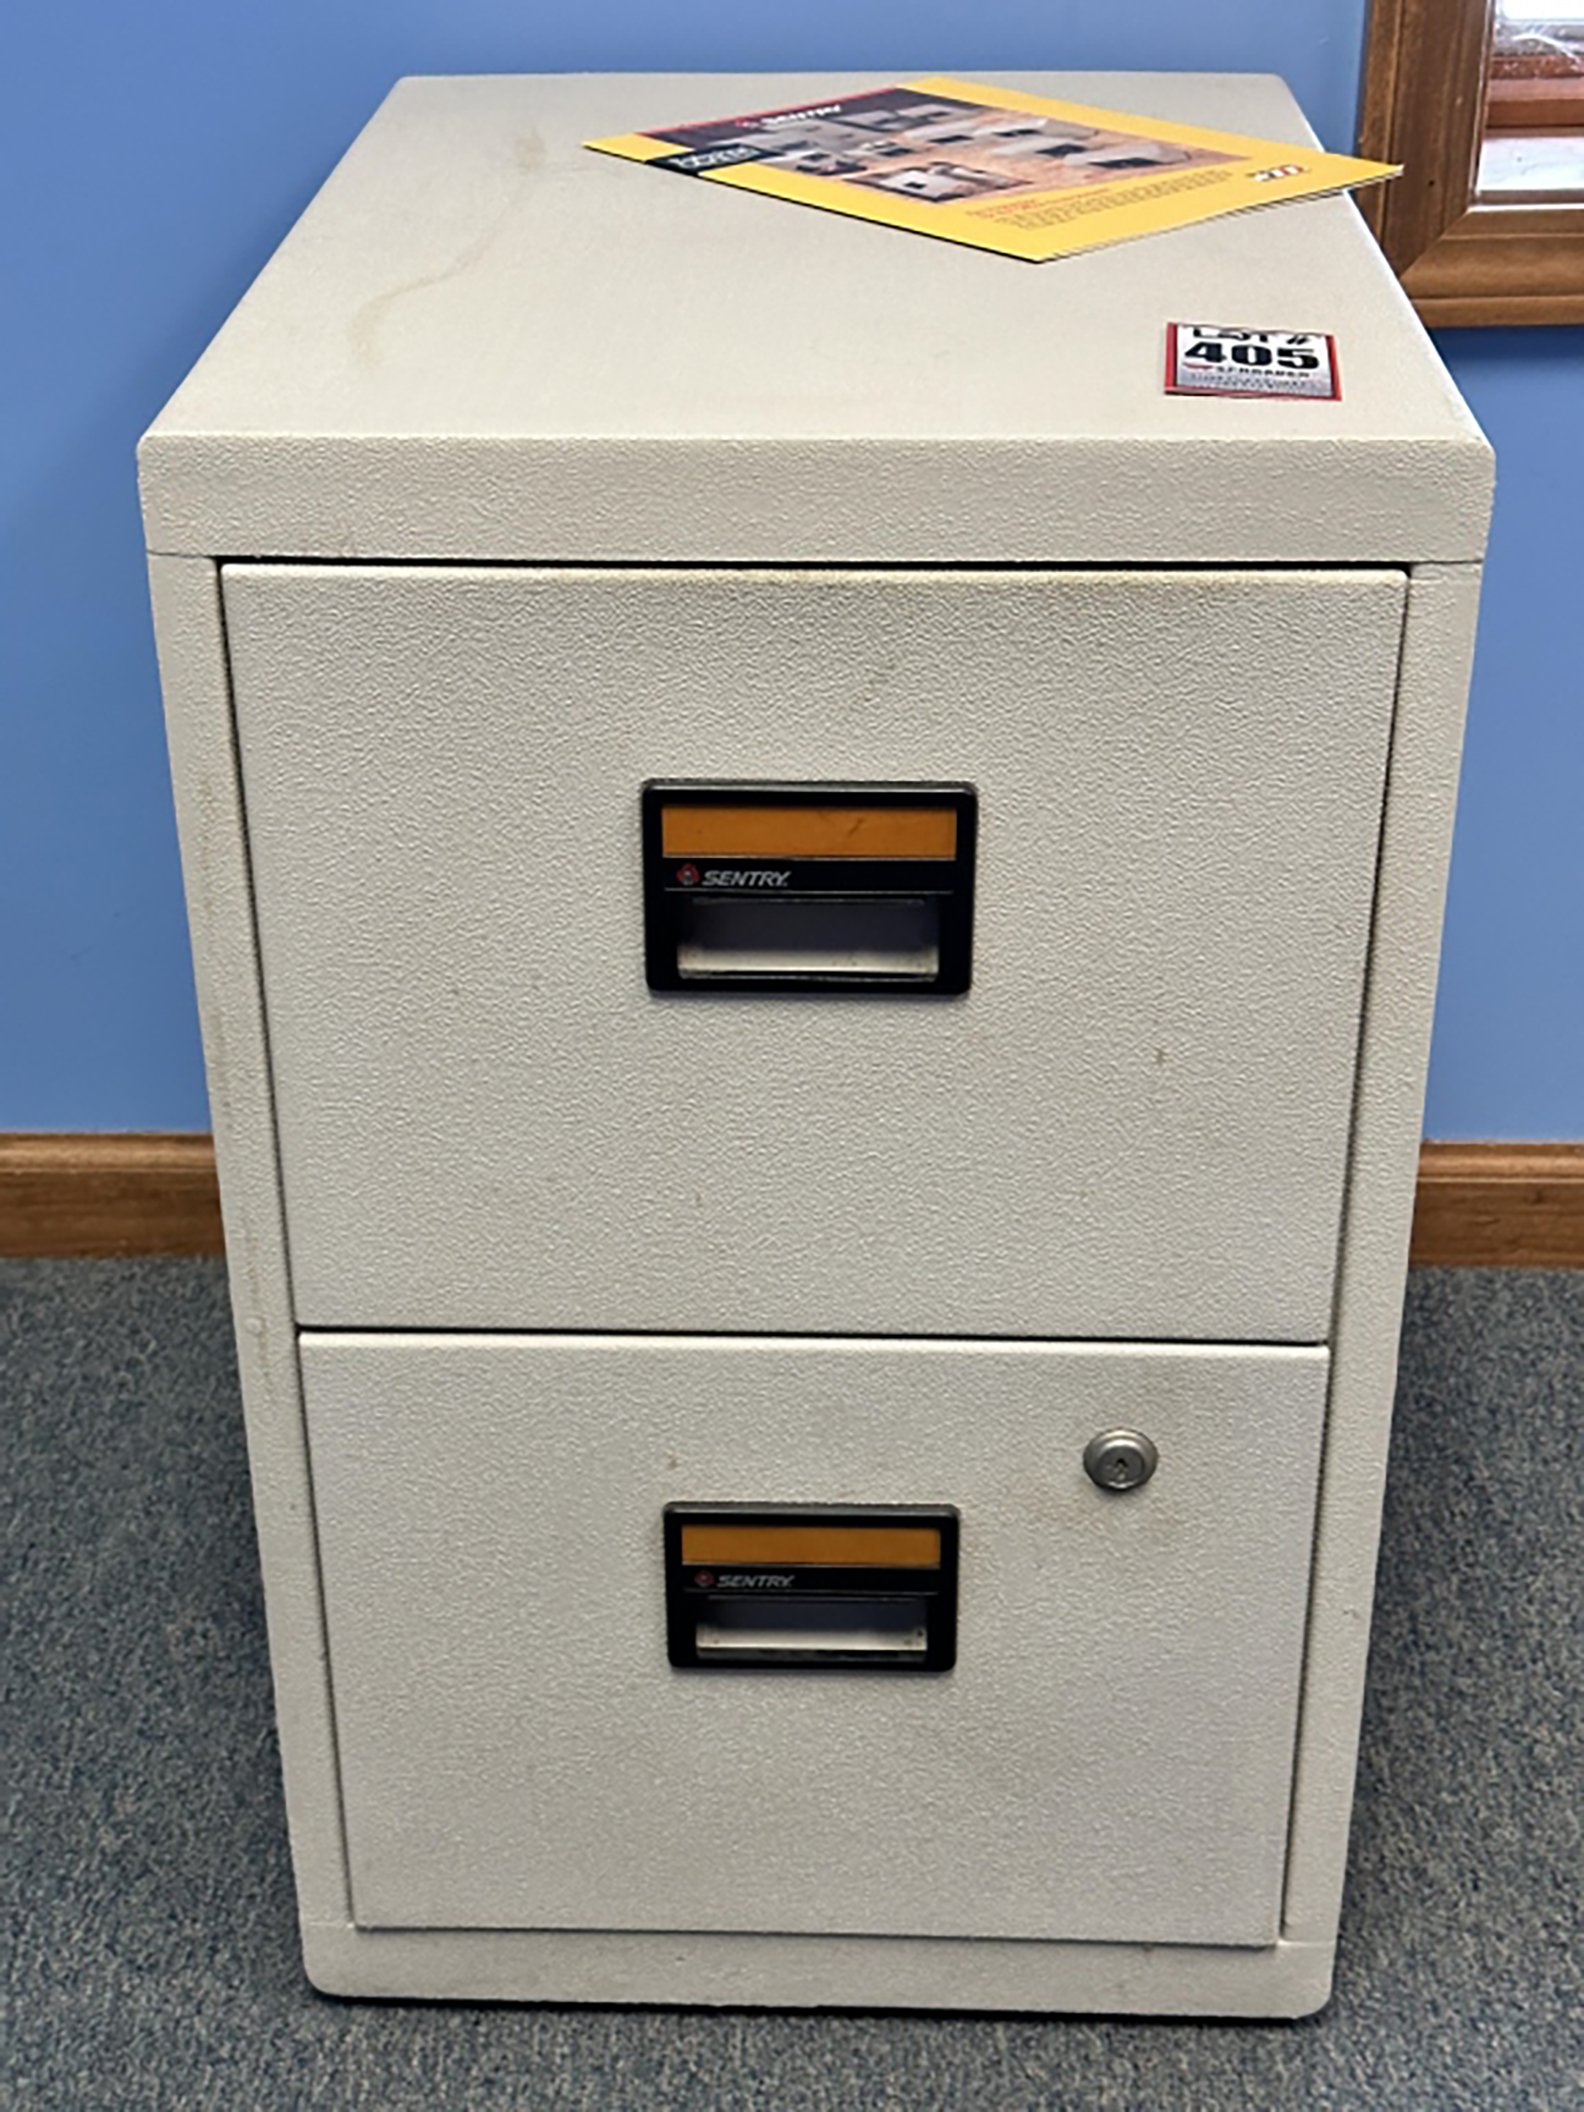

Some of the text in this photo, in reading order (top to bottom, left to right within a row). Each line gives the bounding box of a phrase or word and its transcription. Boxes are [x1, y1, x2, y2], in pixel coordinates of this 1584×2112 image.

[1184, 341, 1320, 370] 405
[702, 870, 791, 886] SENTRY
[717, 1574, 794, 1588] SENTRY
